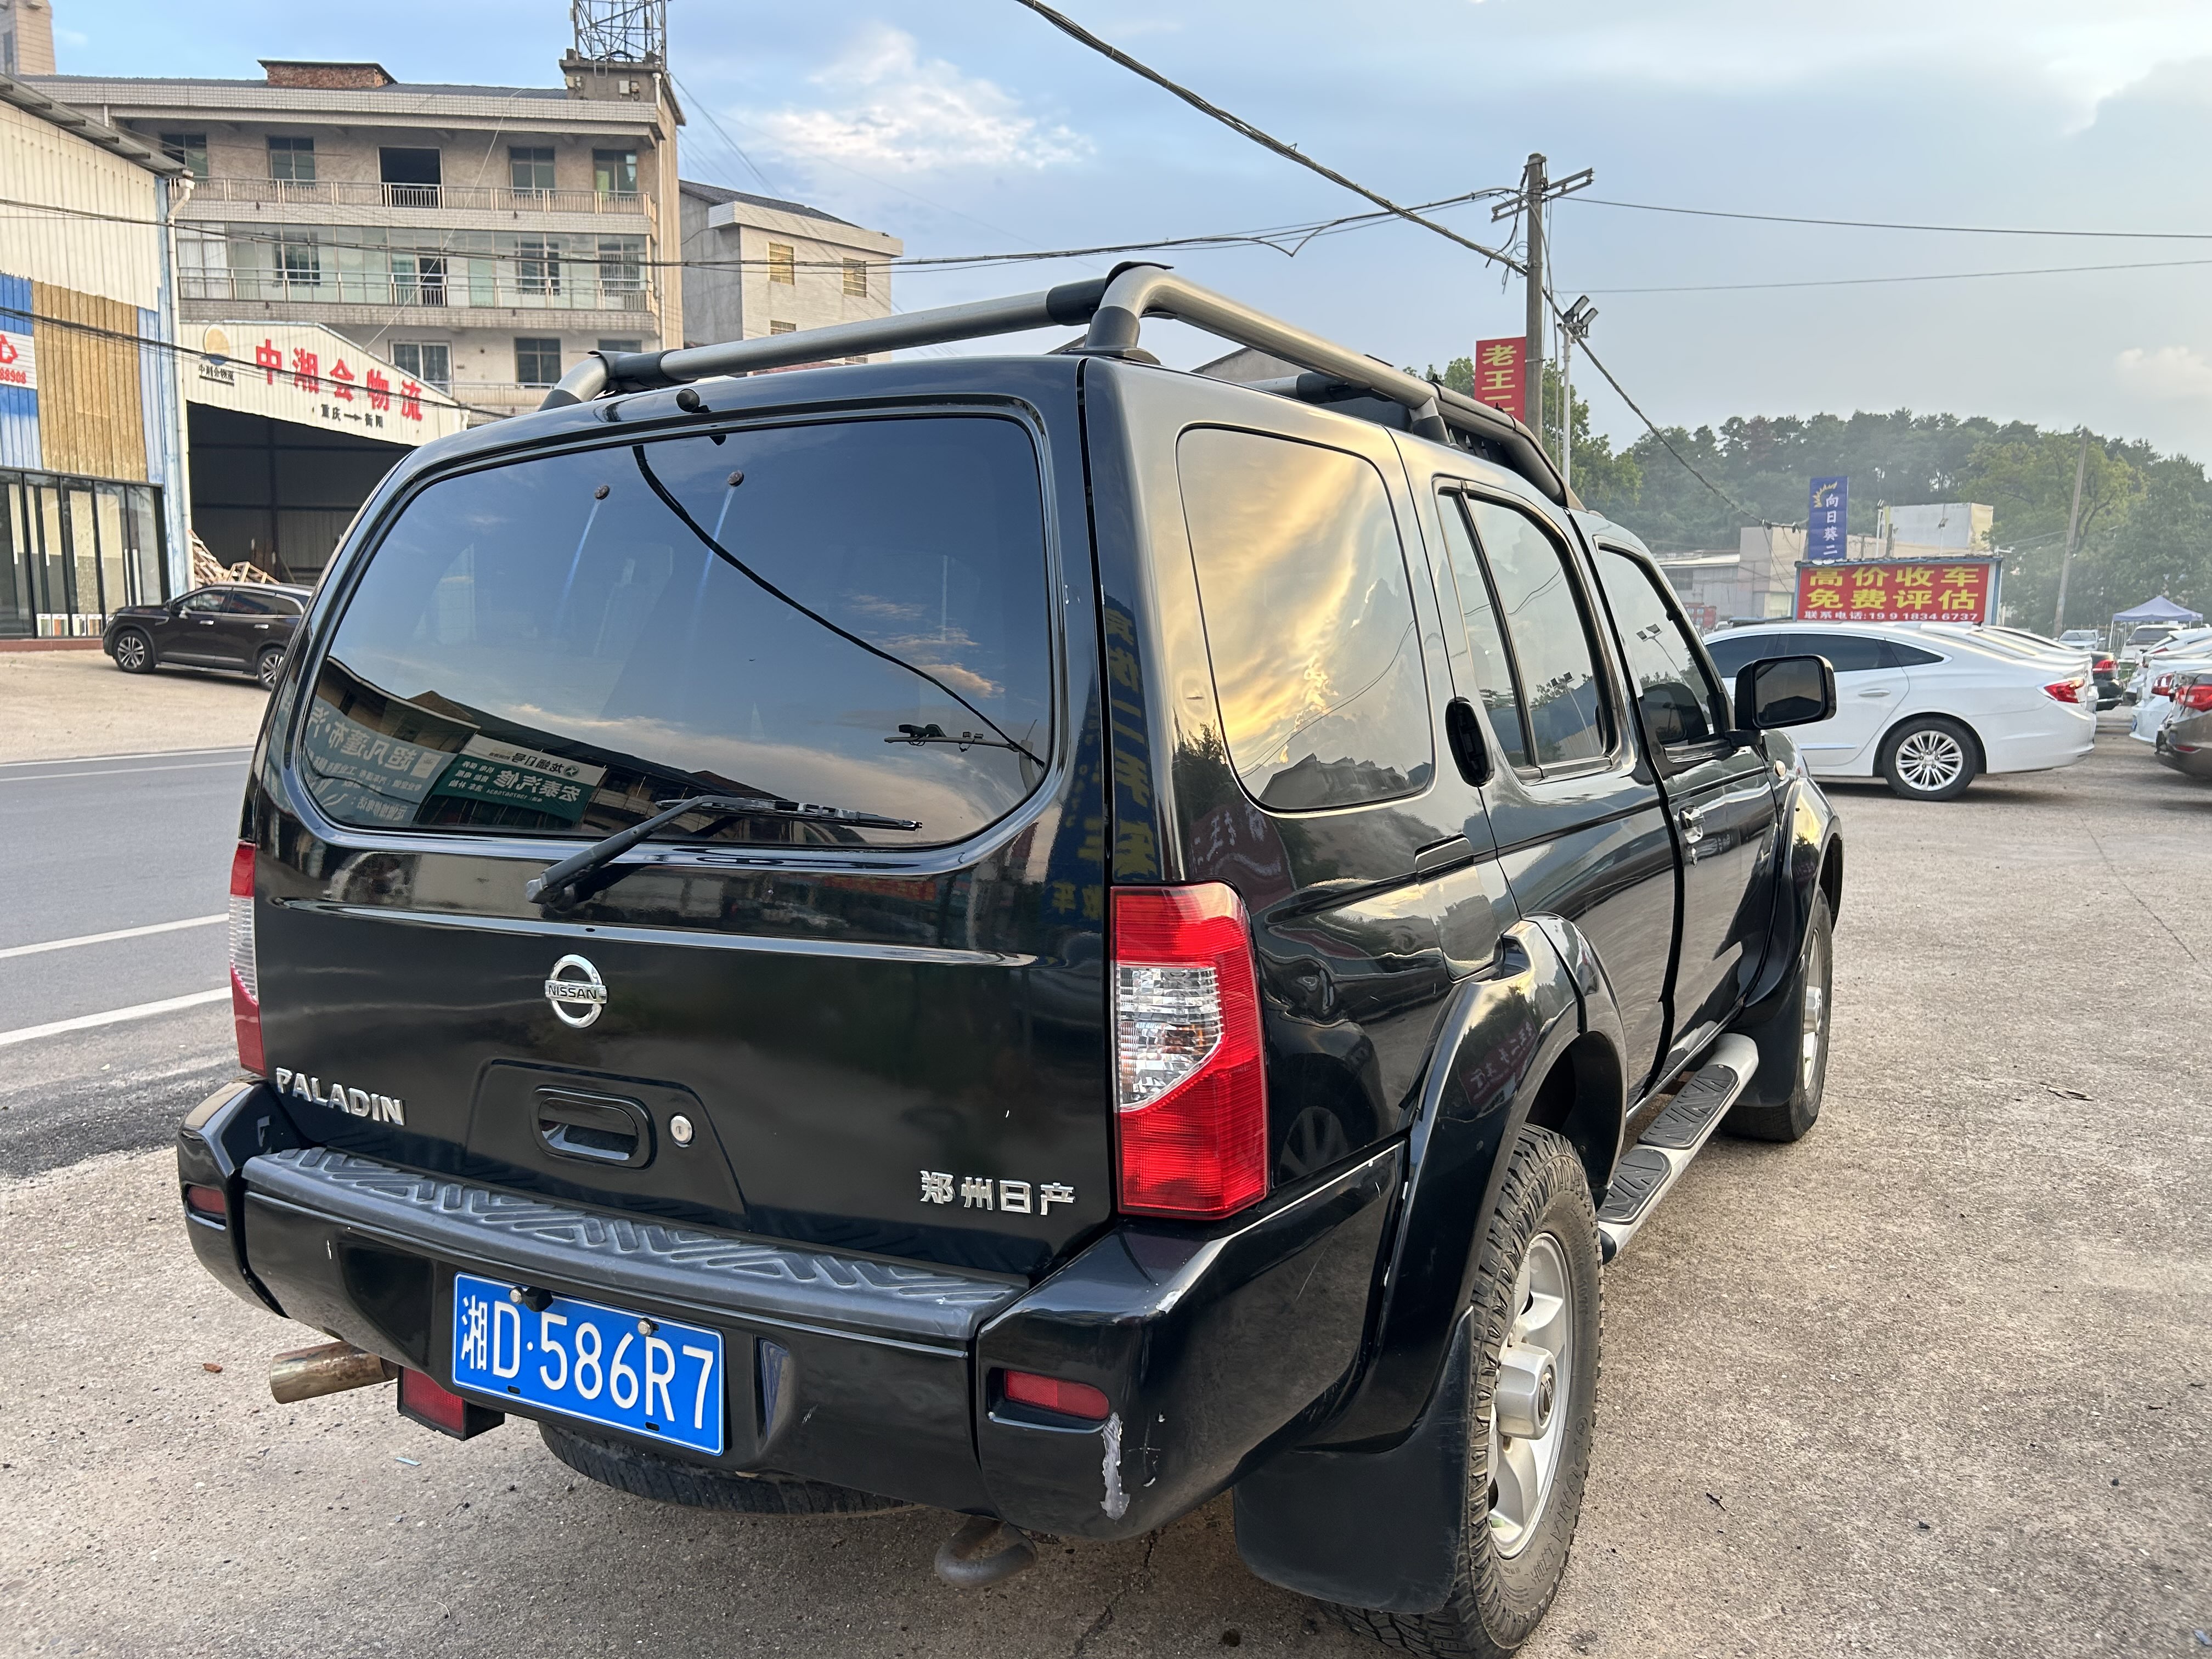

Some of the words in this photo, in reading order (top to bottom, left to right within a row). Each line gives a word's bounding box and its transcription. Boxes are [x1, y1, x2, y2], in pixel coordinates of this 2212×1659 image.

[1822, 493, 1839, 555] 向日葵二
[1807, 567, 1979, 587] 高价收车
[1807, 589, 1978, 610] 免费评估
[549, 985, 597, 1000] NISSAN
[275, 1066, 406, 1126] PALADIN
[919, 1169, 1076, 1216] 郑州日产
[461, 1295, 713, 1429] 湘D·586R7
